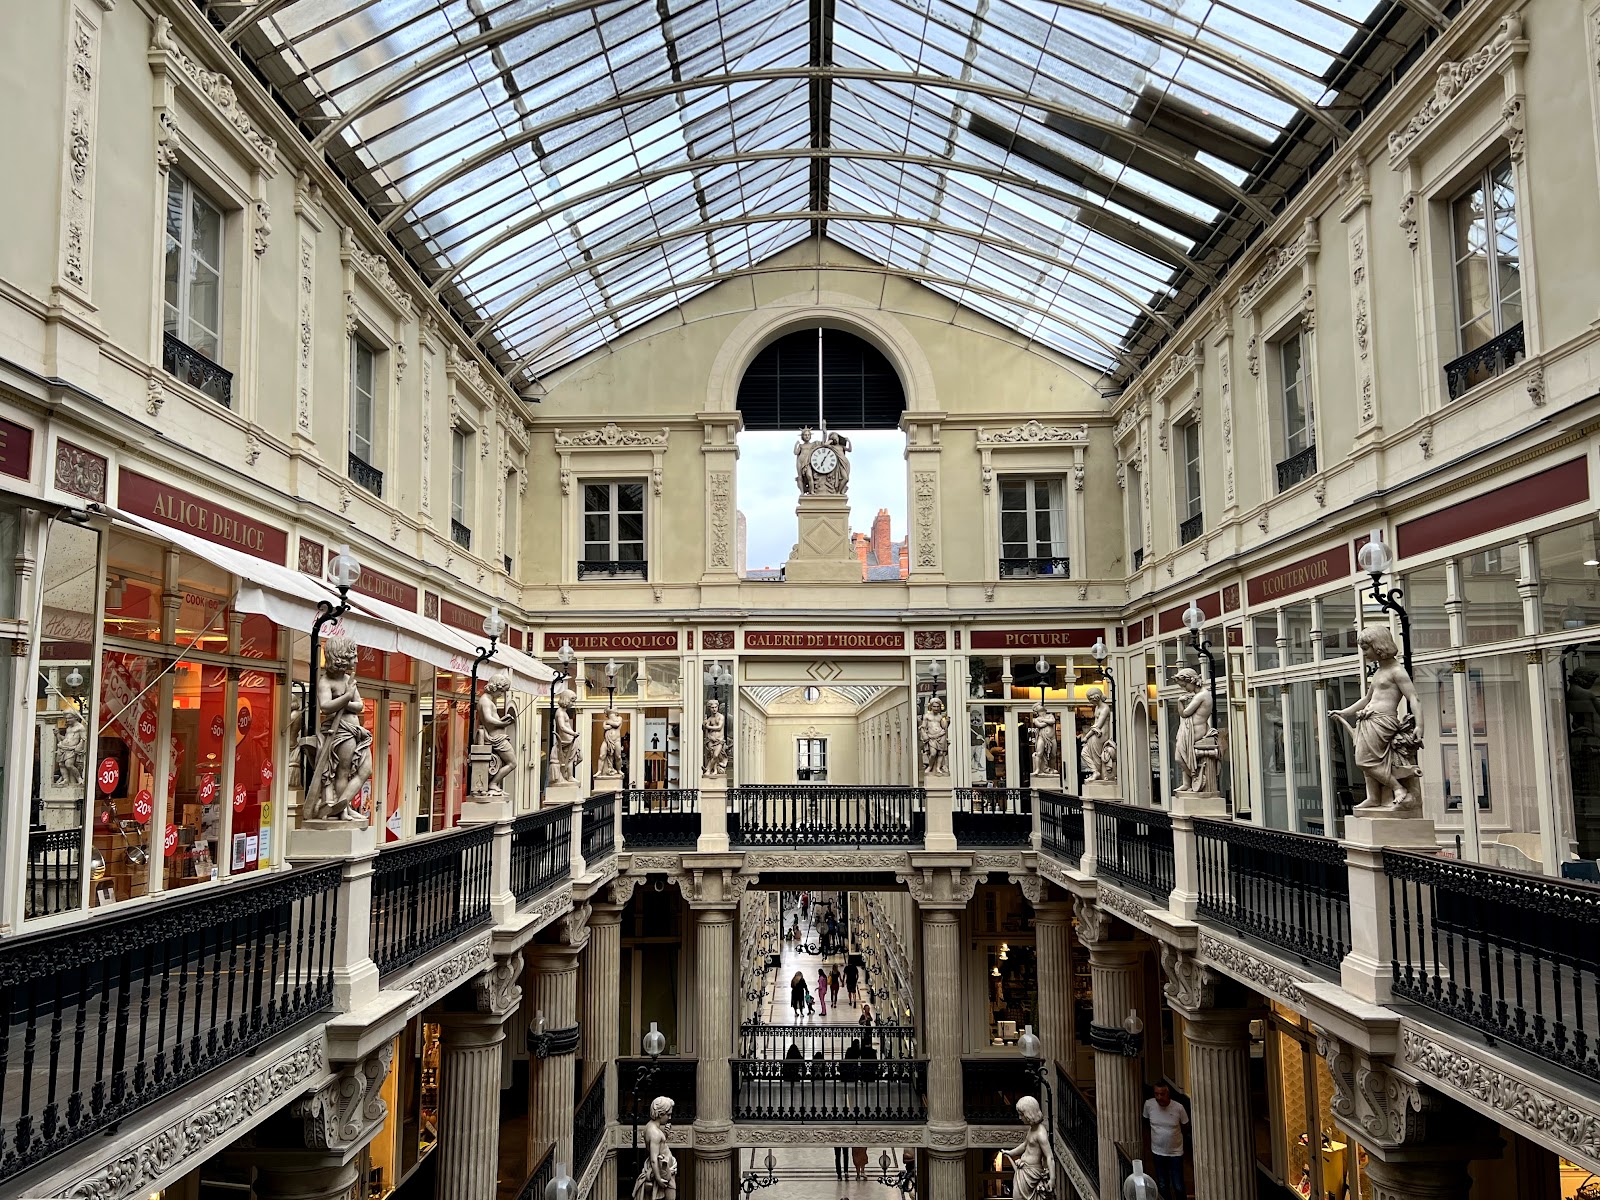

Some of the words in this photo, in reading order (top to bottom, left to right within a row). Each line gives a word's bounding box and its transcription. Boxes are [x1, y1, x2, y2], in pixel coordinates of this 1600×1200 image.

[152, 492, 208, 532] ALICE
[211, 512, 265, 552] DELICE
[1262, 559, 1329, 596] ECOUTERVOIR
[375, 577, 404, 604] DELICE
[546, 636, 609, 648] ATELIER
[611, 635, 677, 648] COQLICO
[747, 634, 803, 646] GALERIE
[807, 634, 824, 646] DE
[827, 634, 902, 647] L'HORLOGE
[1005, 633, 1070, 645] PICTURE
[139, 721, 156, 736] -50%
[98, 768, 119, 784] -30%
[200, 781, 215, 799] -20%
[233, 790, 247, 806] -30%
[134, 800, 152, 816] -20%
